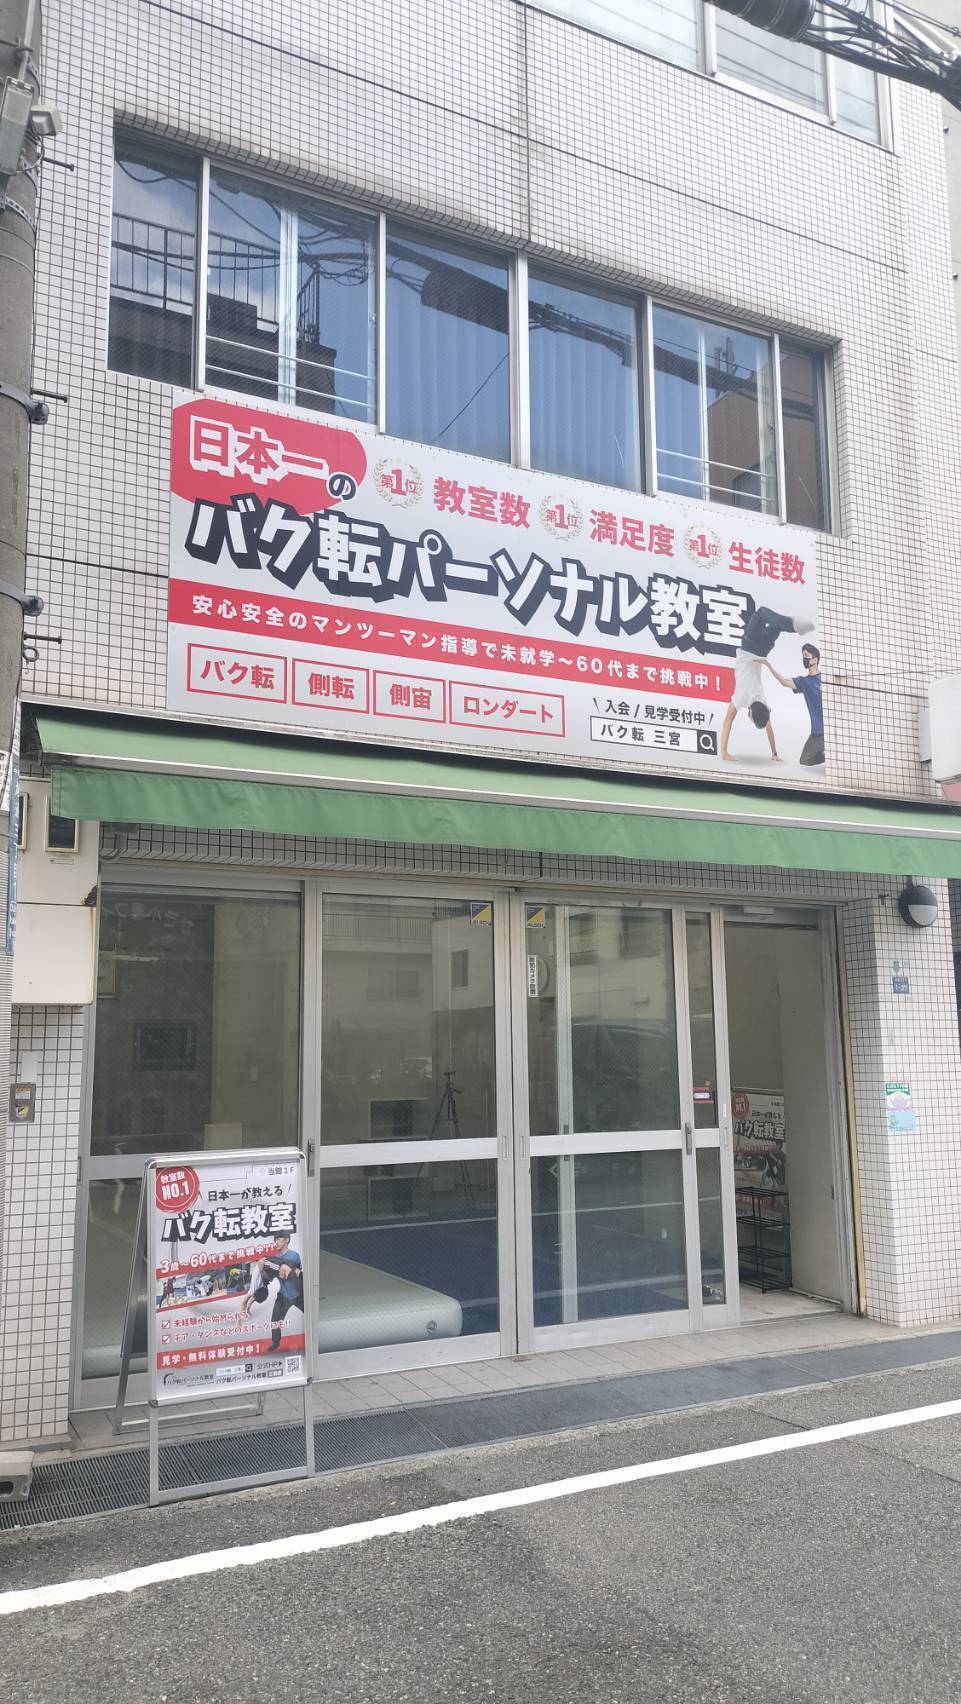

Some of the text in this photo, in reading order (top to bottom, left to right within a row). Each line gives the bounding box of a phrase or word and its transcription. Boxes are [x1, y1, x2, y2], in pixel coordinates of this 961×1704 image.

[190, 415, 357, 499] 日本一の
[380, 469, 806, 585] 第1位 教室数 第1位 満足度 第1位 生徒数
[187, 494, 753, 655] バク転パーソナル教室
[200, 659, 275, 690] バク転
[308, 672, 355, 700] 側転
[389, 683, 432, 711] 側宙
[463, 695, 554, 725] ロンダート
[601, 723, 681, 747] バク転 三宮
[160, 1171, 186, 1184] 教室数
[161, 1180, 190, 1201] NO.1
[208, 1185, 283, 1202] 日本一が教える
[161, 1202, 297, 1244] バク転教室
